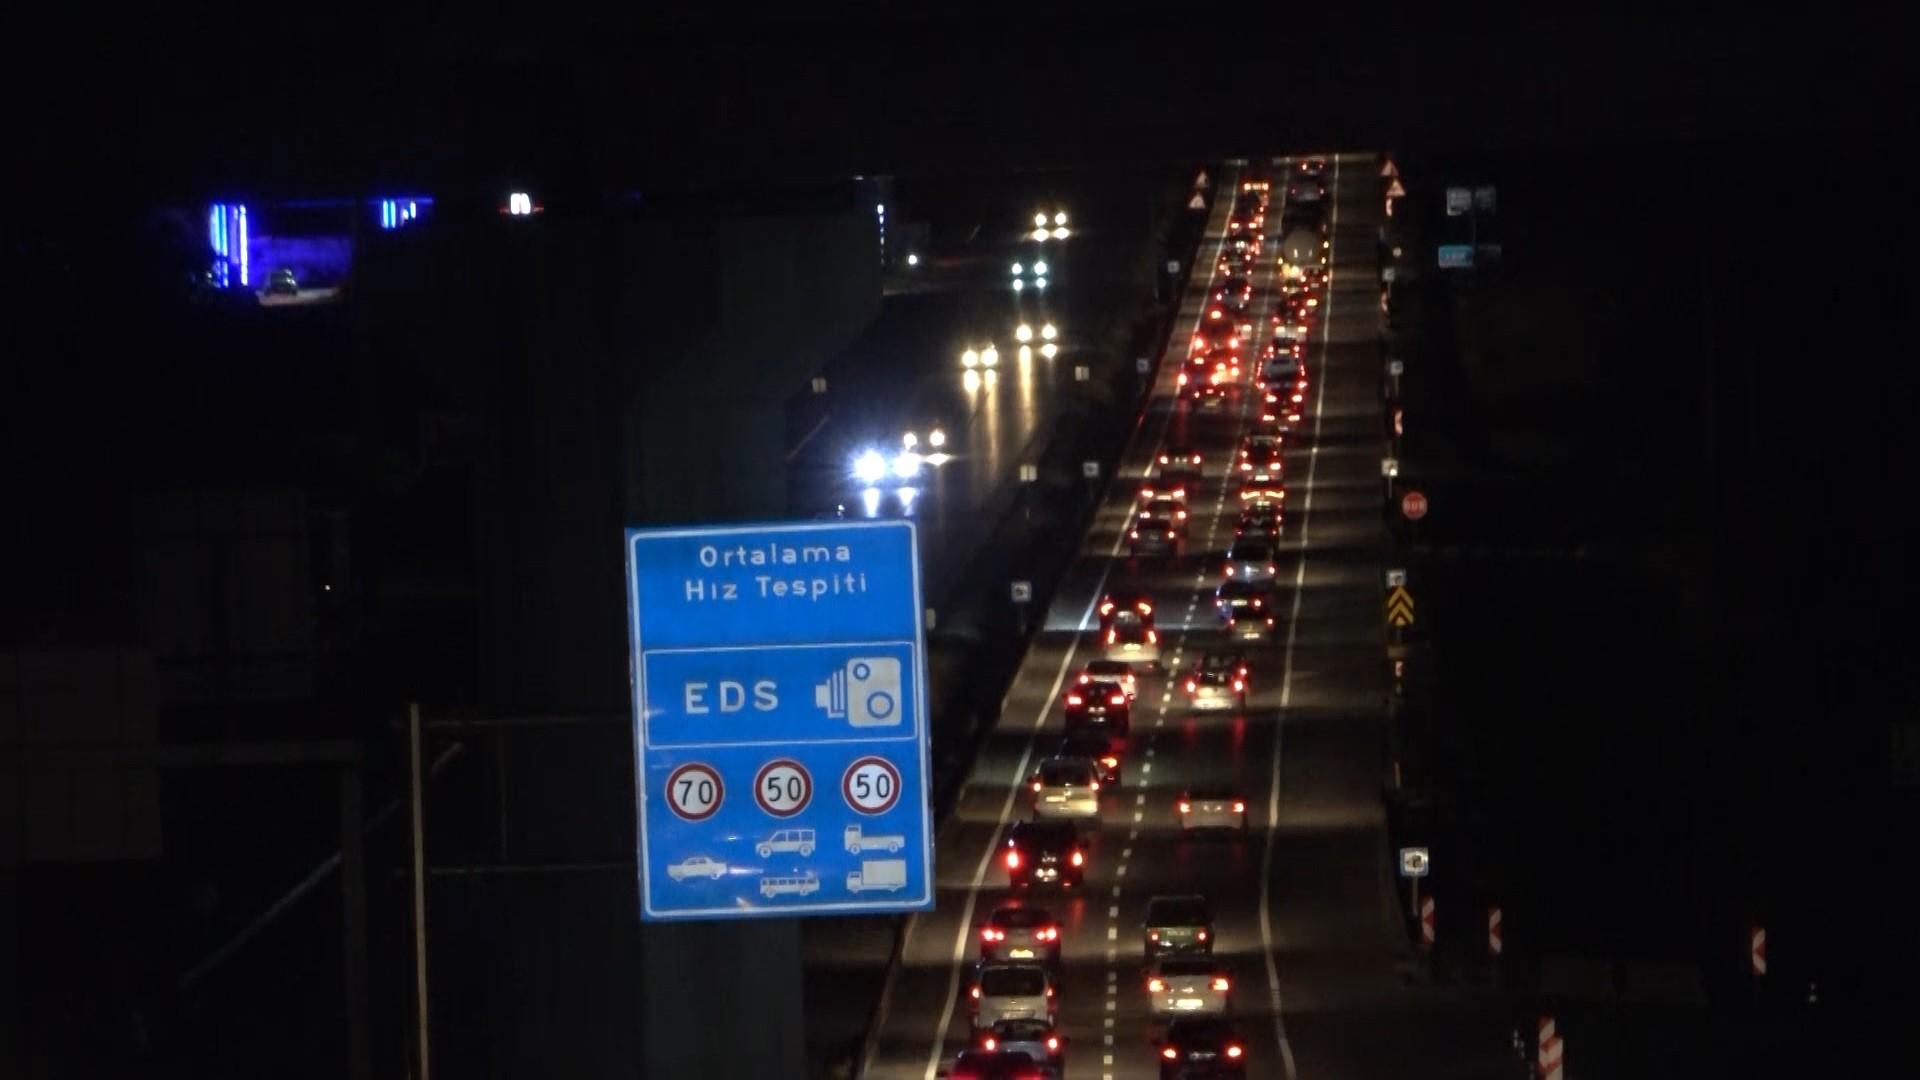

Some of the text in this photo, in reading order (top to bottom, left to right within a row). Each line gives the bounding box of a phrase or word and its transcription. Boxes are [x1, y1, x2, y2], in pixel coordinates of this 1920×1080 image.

[700, 544, 850, 567] Ortalama
[685, 573, 866, 601] Hız Tespiti
[685, 681, 779, 714] EDS
[679, 781, 713, 806] 70
[767, 777, 801, 802] 50
[856, 773, 891, 799] 50
